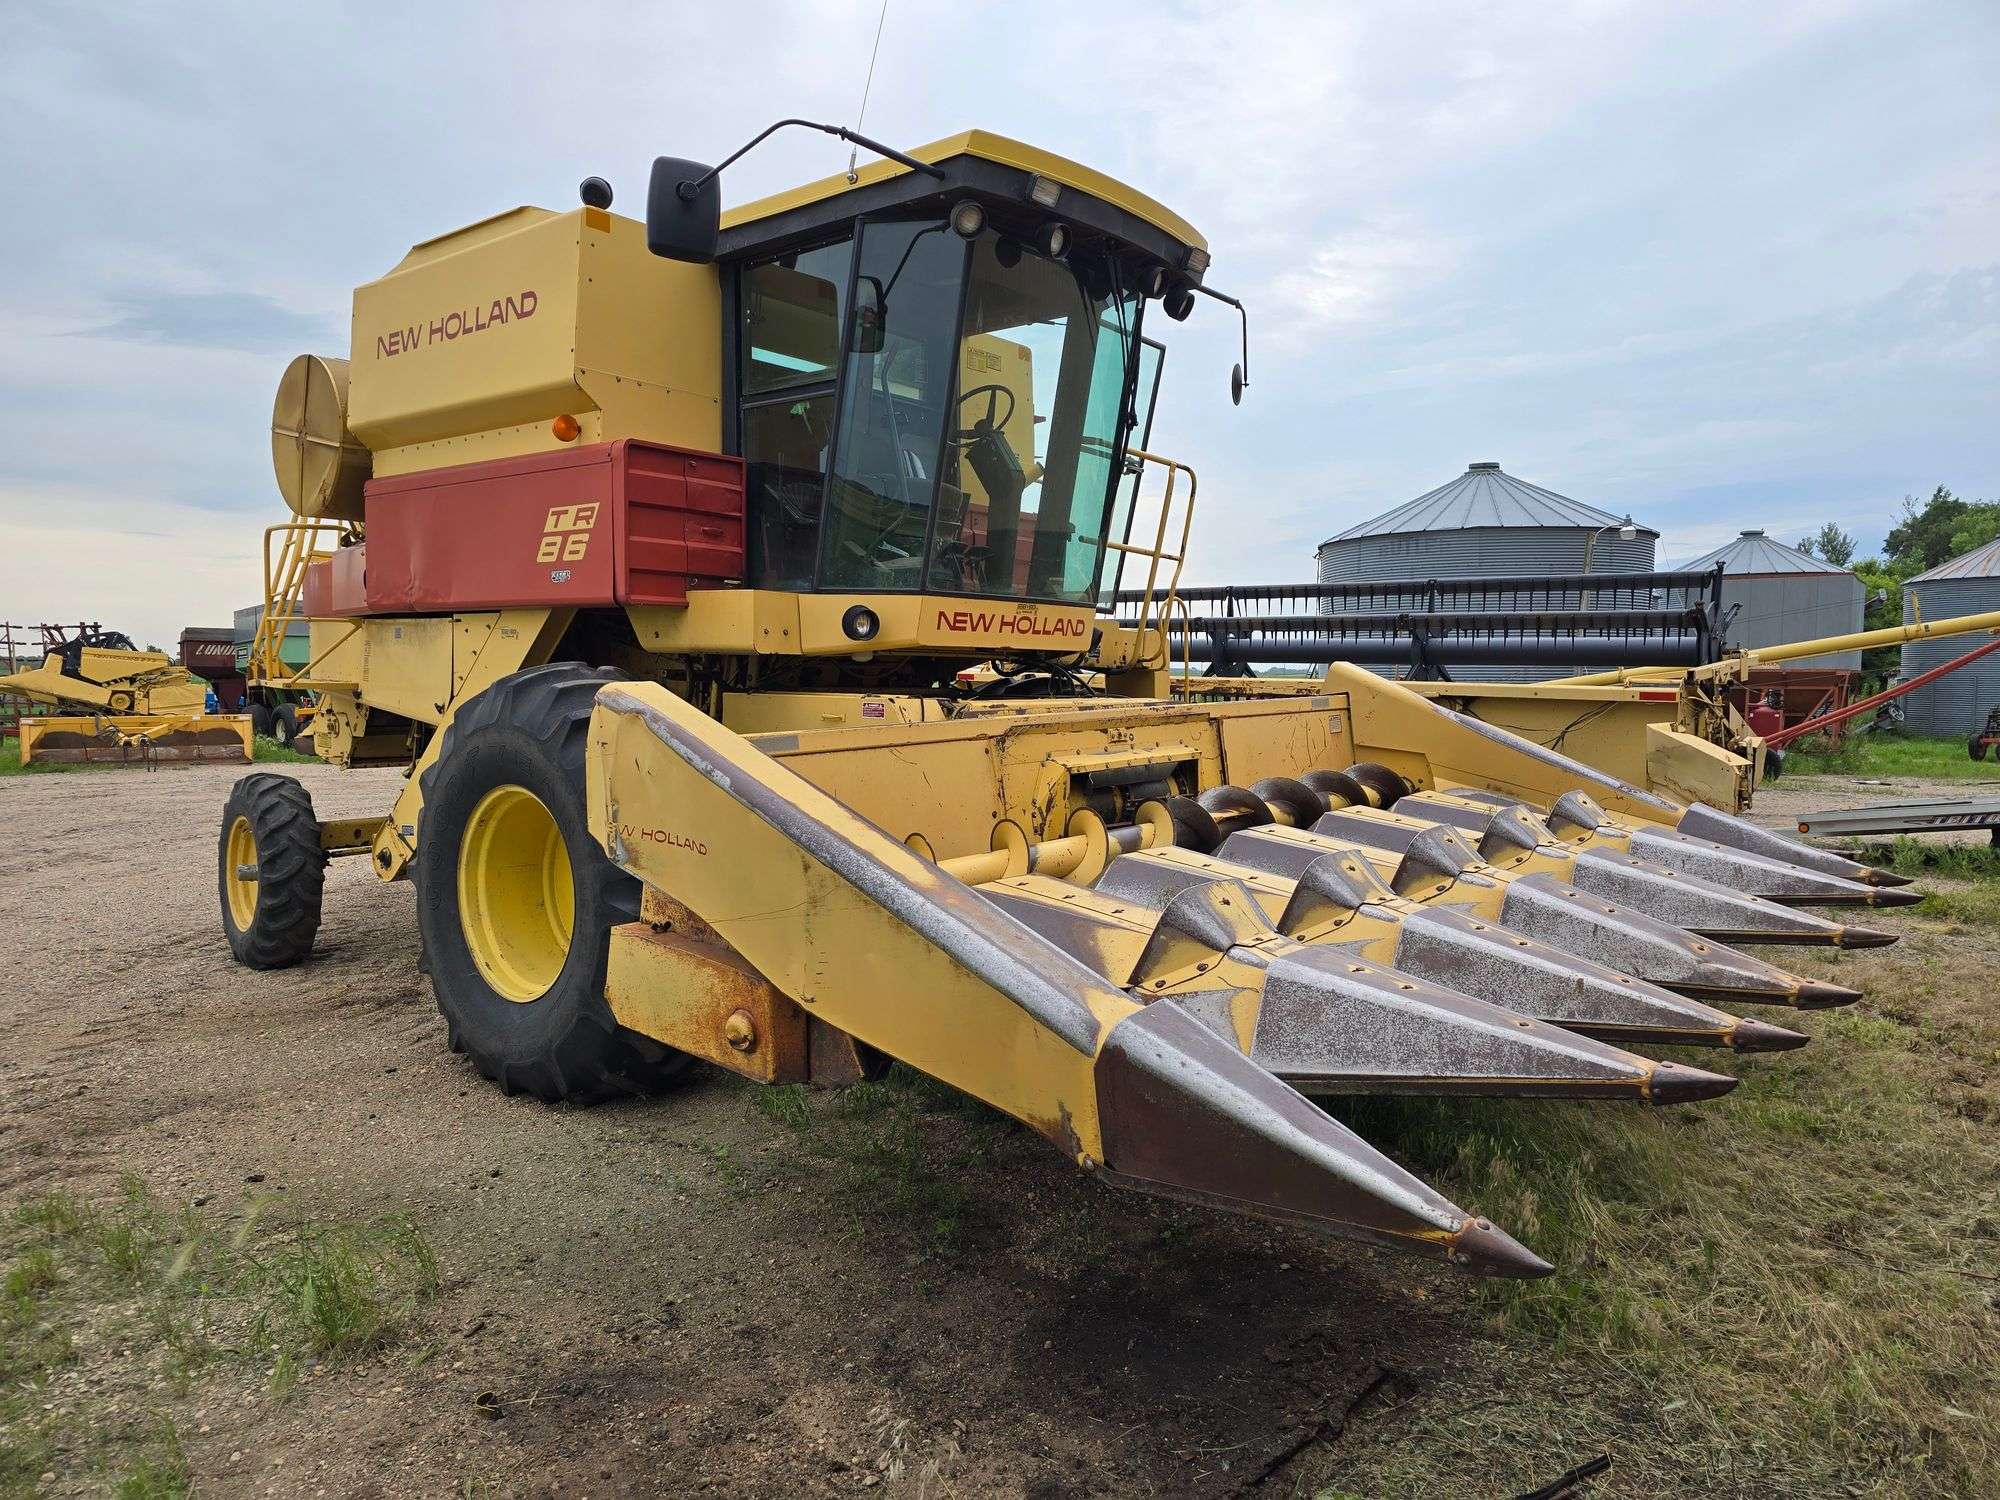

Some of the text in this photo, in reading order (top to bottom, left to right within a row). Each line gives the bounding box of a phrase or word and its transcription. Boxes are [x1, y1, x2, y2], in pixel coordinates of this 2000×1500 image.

[377, 290, 538, 360] NEW HOLLAND
[547, 503, 598, 530] TR
[536, 533, 590, 563] 86
[936, 611, 1086, 637] NEW HOLLAND
[641, 827, 708, 856] HOLLAND
